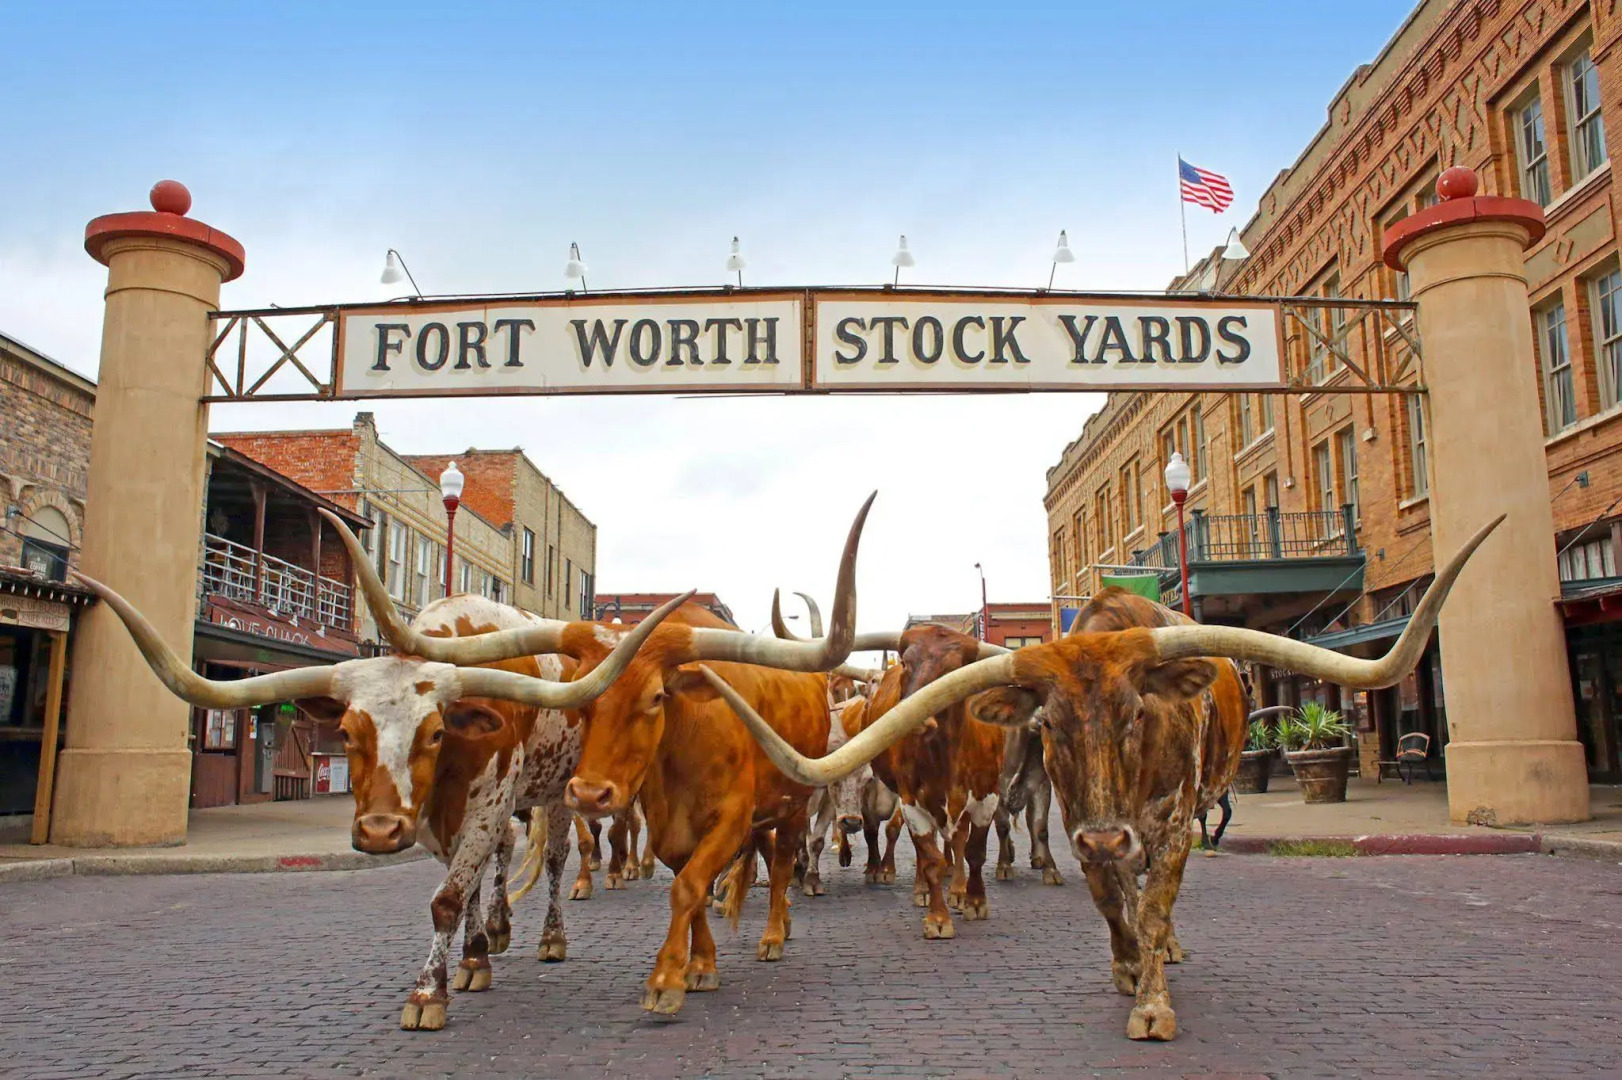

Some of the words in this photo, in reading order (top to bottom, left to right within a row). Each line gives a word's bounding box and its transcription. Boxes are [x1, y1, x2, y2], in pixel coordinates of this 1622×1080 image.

[371, 318, 536, 371] FORT
[568, 316, 781, 367] WORTH
[835, 315, 1031, 365] STOCK
[1057, 314, 1252, 365] YARDS
[1161, 588, 1179, 605] OTEL
